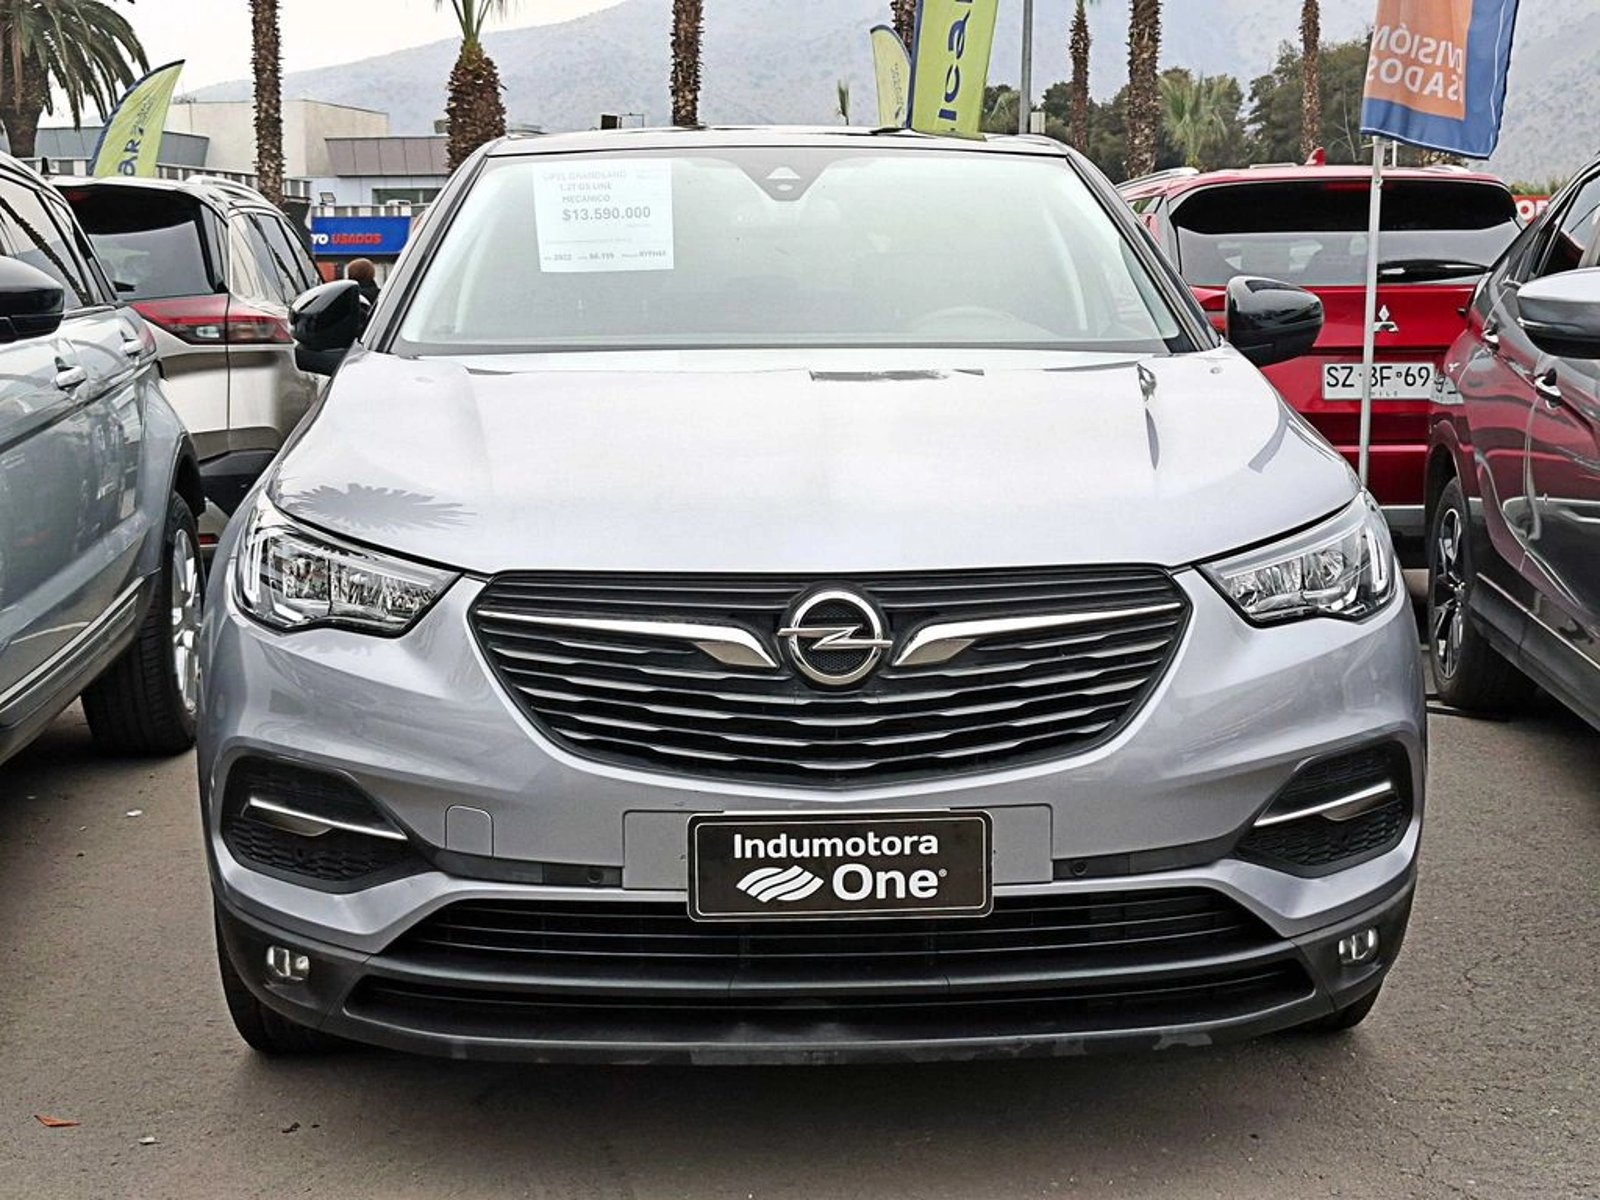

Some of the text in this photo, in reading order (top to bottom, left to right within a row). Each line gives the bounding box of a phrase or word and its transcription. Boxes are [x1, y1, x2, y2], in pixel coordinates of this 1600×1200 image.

[562, 206, 651, 221] $13.590.000
[331, 233, 382, 244] USADOS
[733, 831, 939, 859] Indumotora
